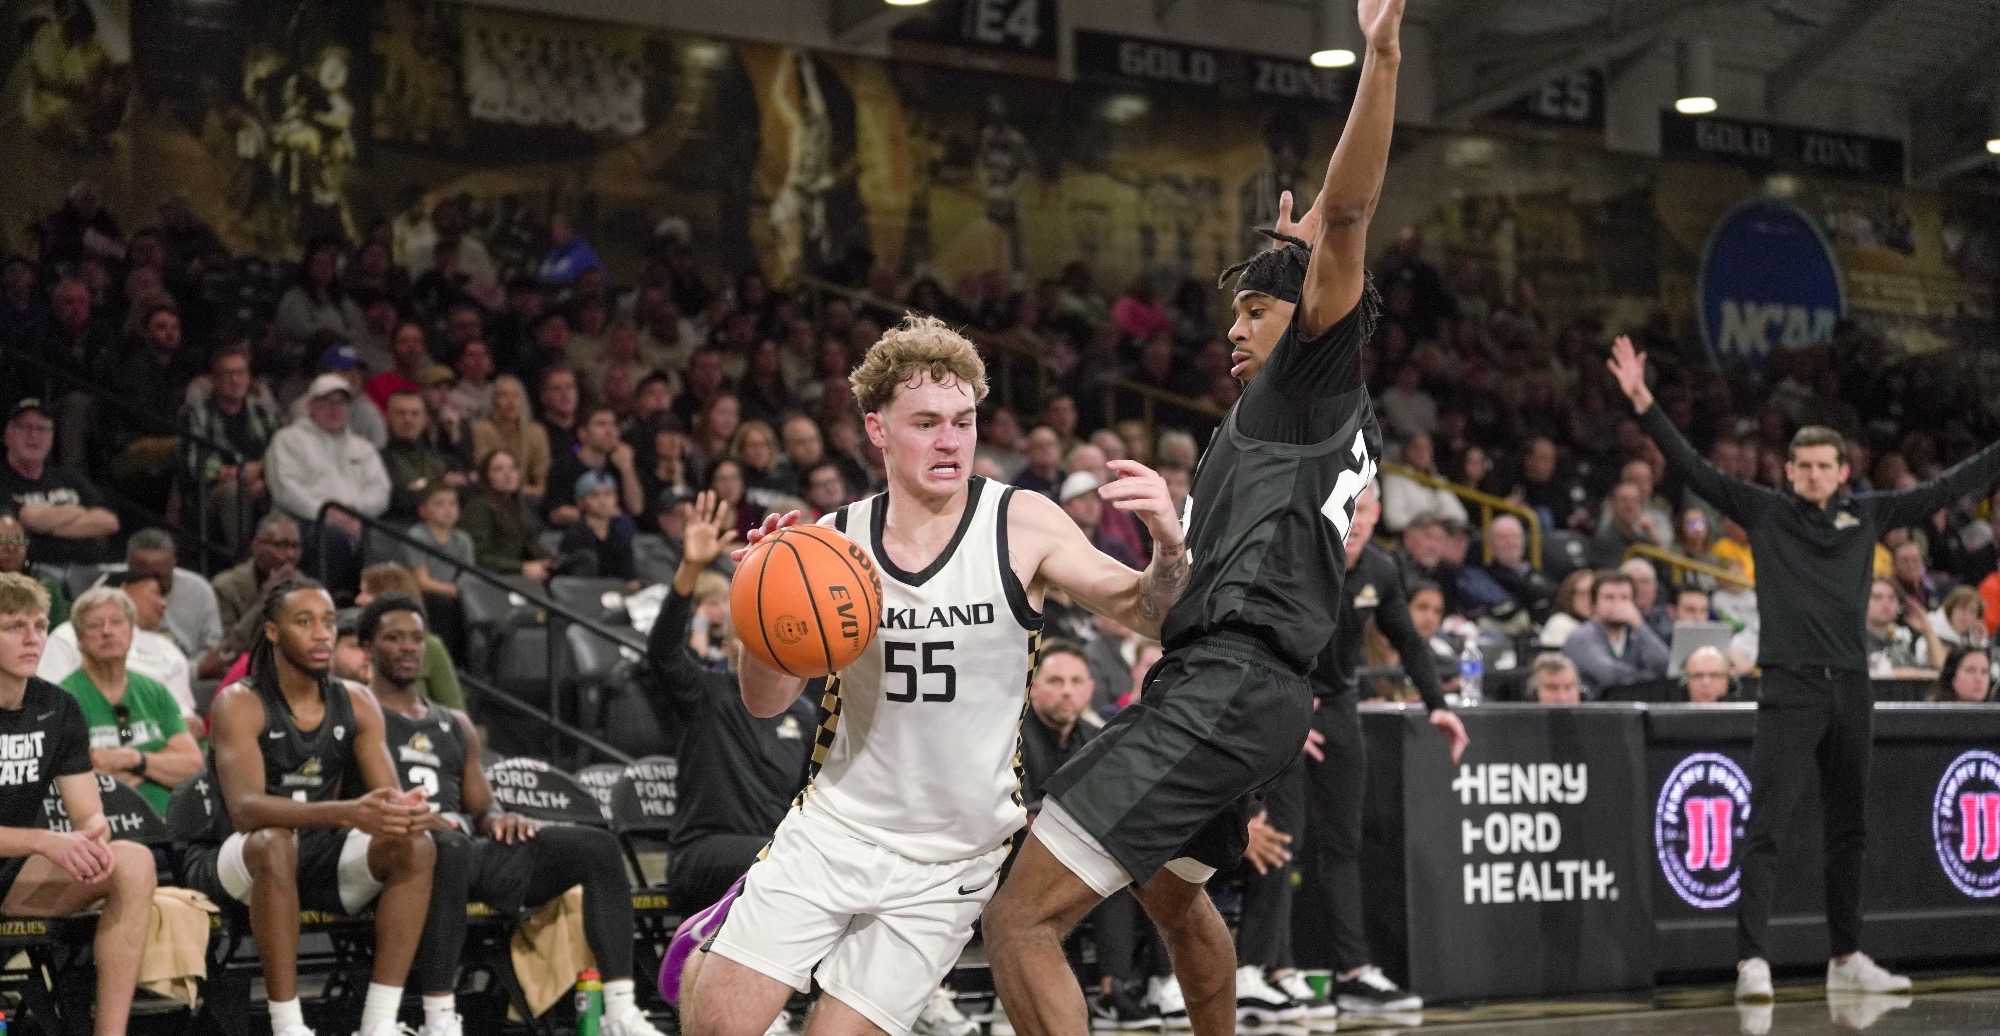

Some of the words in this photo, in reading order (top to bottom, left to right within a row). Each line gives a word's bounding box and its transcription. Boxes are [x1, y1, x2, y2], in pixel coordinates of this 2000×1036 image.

[976, 0, 1040, 48] E4
[1119, 41, 1218, 86] GOLD
[1253, 60, 1344, 103] ZONE
[1696, 120, 1771, 158] GOLD
[1803, 135, 1869, 169] ZONE
[1719, 299, 1836, 356] NCAA
[828, 584, 859, 639] EVO
[879, 602, 995, 630] KLAND
[884, 640, 957, 703] 55
[0, 730, 46, 760] IGHT
[0, 757, 40, 786] ATE
[1452, 762, 1588, 805] HENRY
[1461, 812, 1562, 855] FORD
[0, 920, 46, 935] IZZLIES
